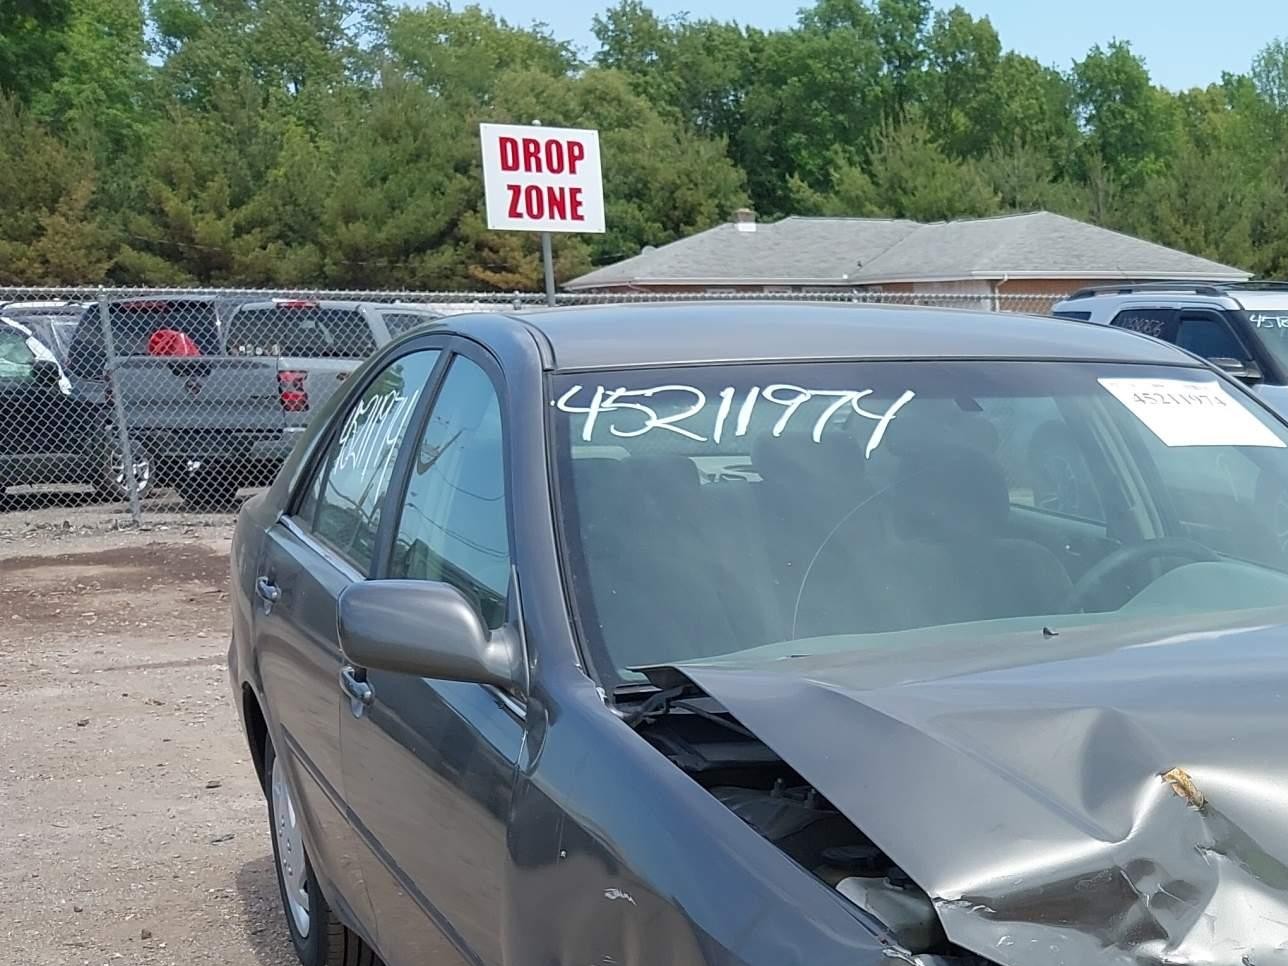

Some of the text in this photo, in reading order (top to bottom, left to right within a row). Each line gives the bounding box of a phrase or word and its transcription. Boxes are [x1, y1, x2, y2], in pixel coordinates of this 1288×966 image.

[498, 136, 585, 175] DROP
[506, 184, 585, 221] ZONE
[1133, 392, 1228, 408] 45211974
[553, 384, 916, 460] 45211974
